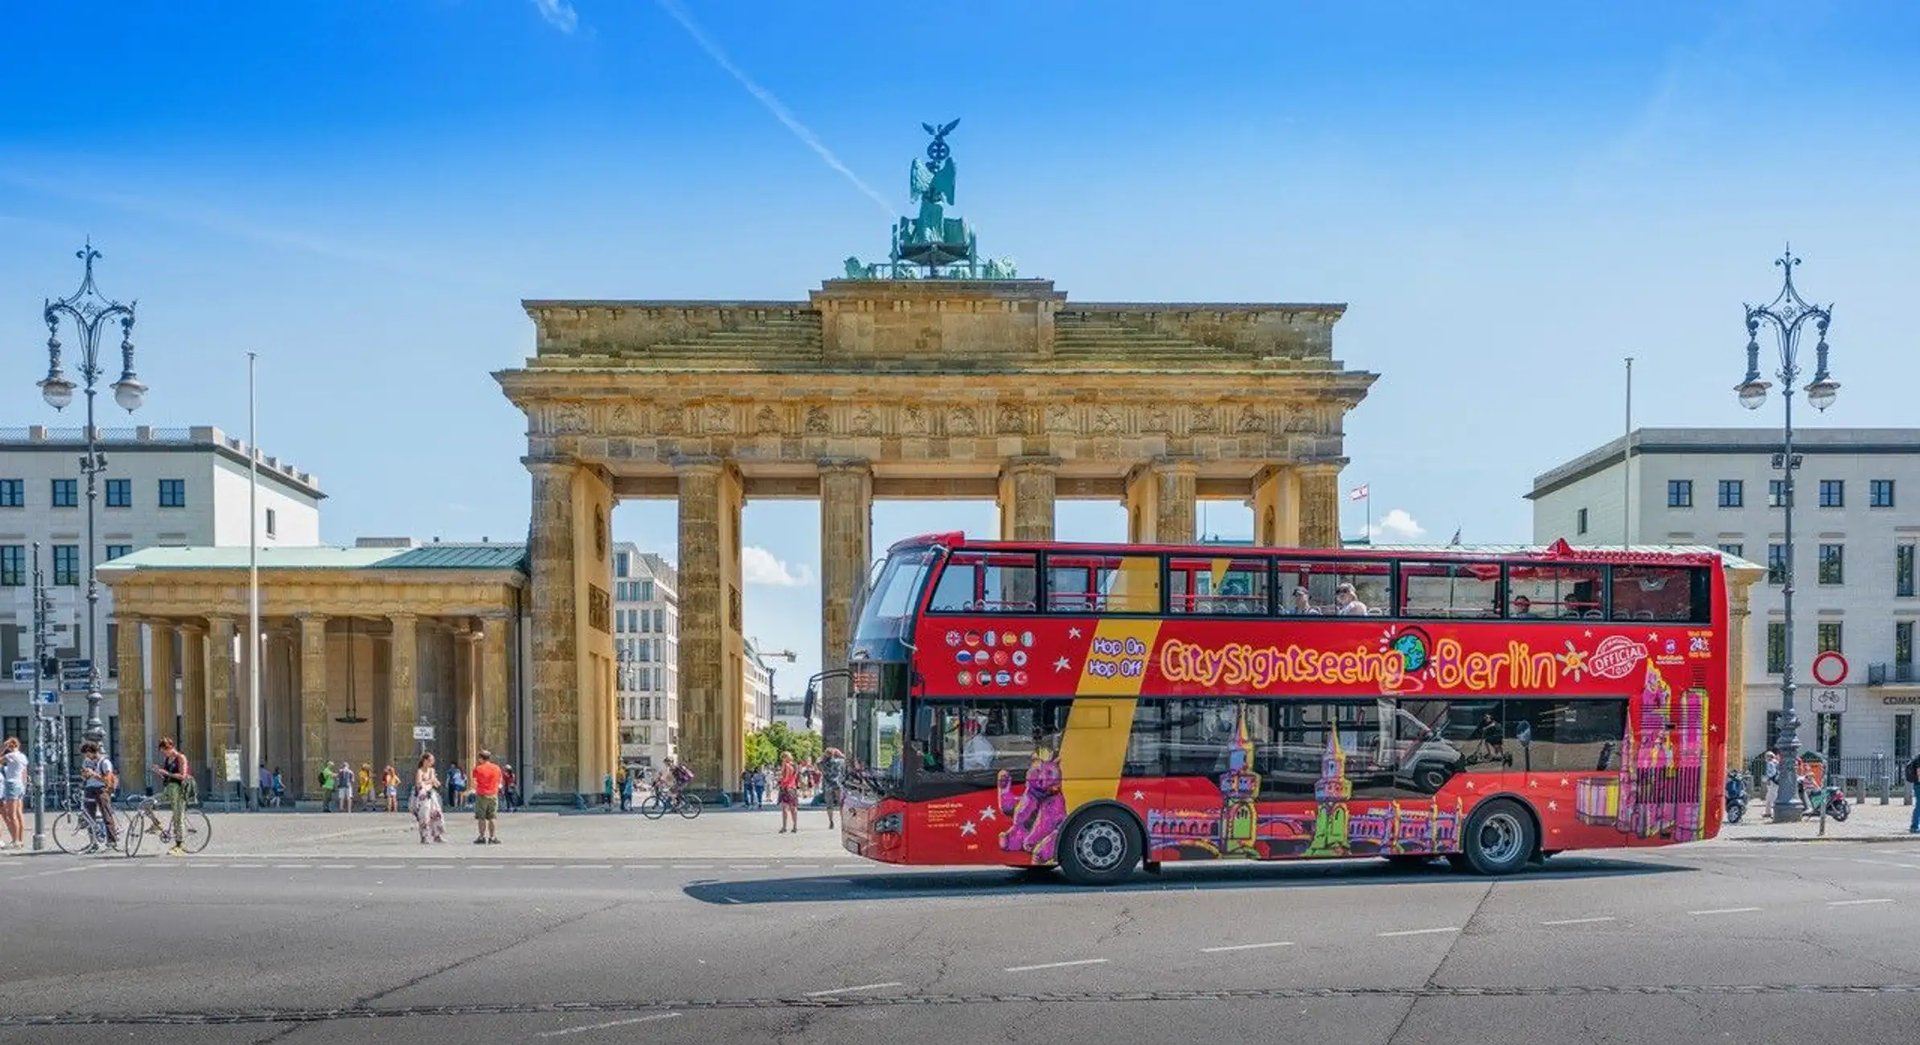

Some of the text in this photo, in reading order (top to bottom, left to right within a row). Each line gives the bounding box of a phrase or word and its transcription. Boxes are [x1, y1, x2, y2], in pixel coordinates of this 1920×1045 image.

[1093, 637, 1146, 657] Hop On
[1594, 645, 1642, 671] OFFICIAL
[1088, 658, 1143, 678] Hop Off
[1436, 638, 1557, 690] Berlin
